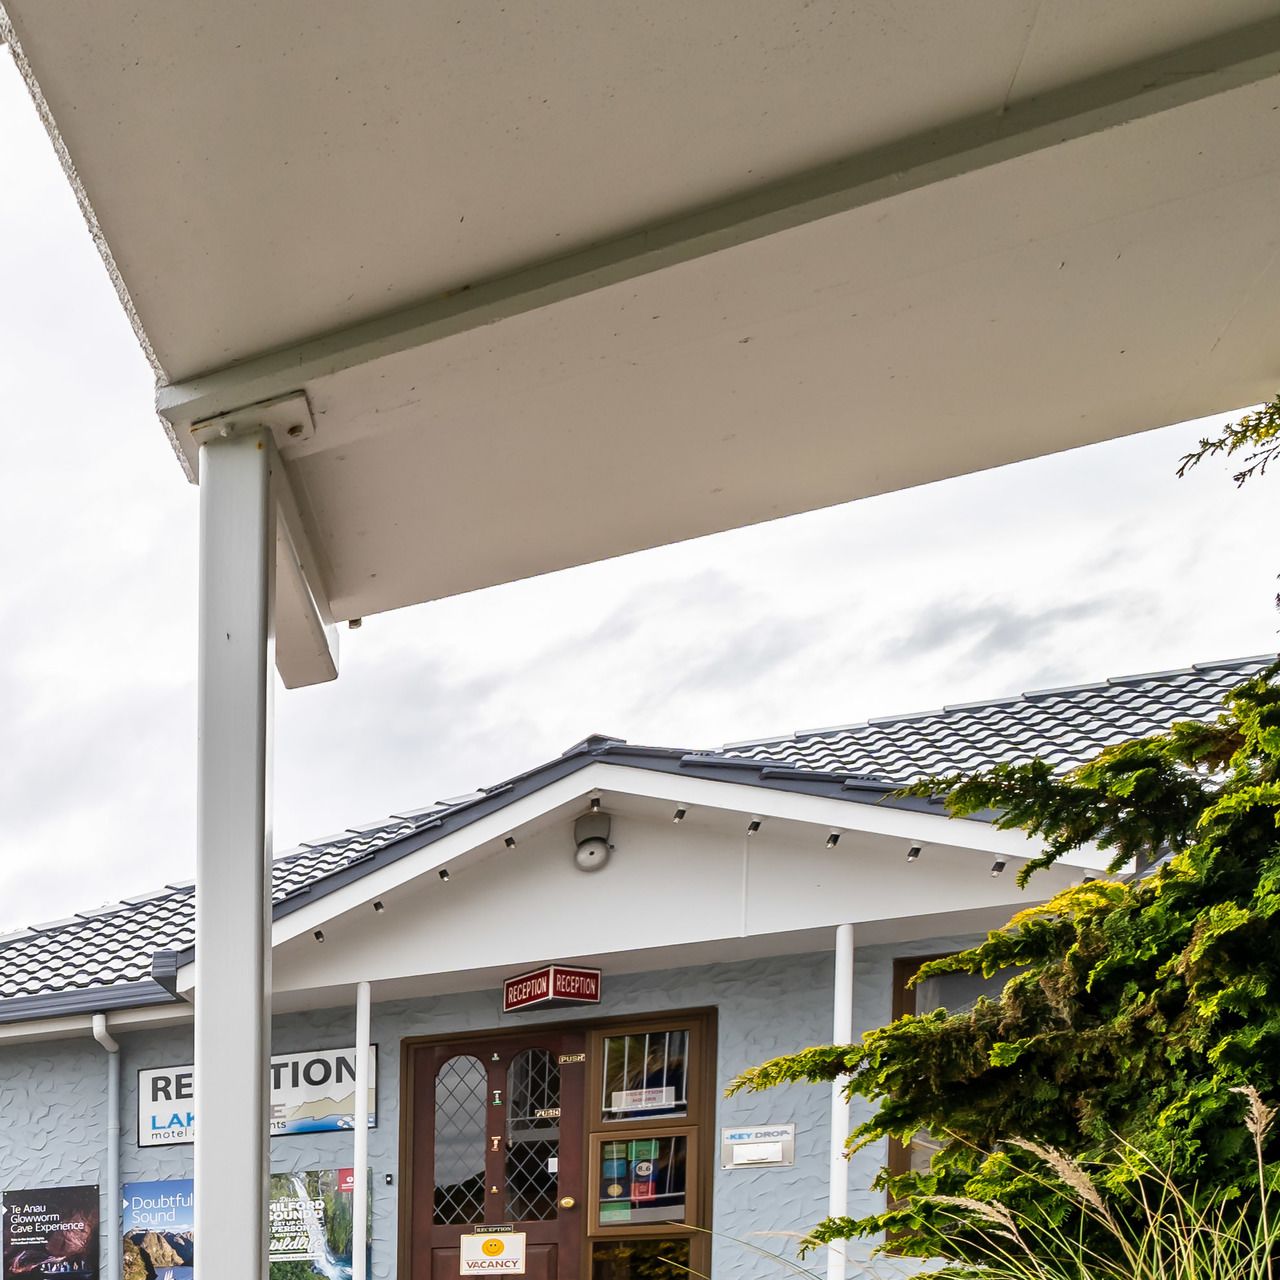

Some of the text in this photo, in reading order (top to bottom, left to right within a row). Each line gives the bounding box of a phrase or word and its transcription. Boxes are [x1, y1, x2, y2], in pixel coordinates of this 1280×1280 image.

[508, 976, 547, 1004] RECEPTION
[556, 974, 596, 995] RECEPTION
[561, 1055, 583, 1063] PUSH
[152, 1055, 356, 1102] RETION
[152, 1127, 188, 1139] motel
[729, 1130, 789, 1140] KEY DROP
[132, 1192, 193, 1210] Doubtful
[10, 1204, 46, 1214] Te Anau
[10, 1213, 60, 1223] Glowworm
[132, 1208, 176, 1224] Sound
[10, 1222, 84, 1233] Cave Experience
[466, 1260, 519, 1269] VACANCY
